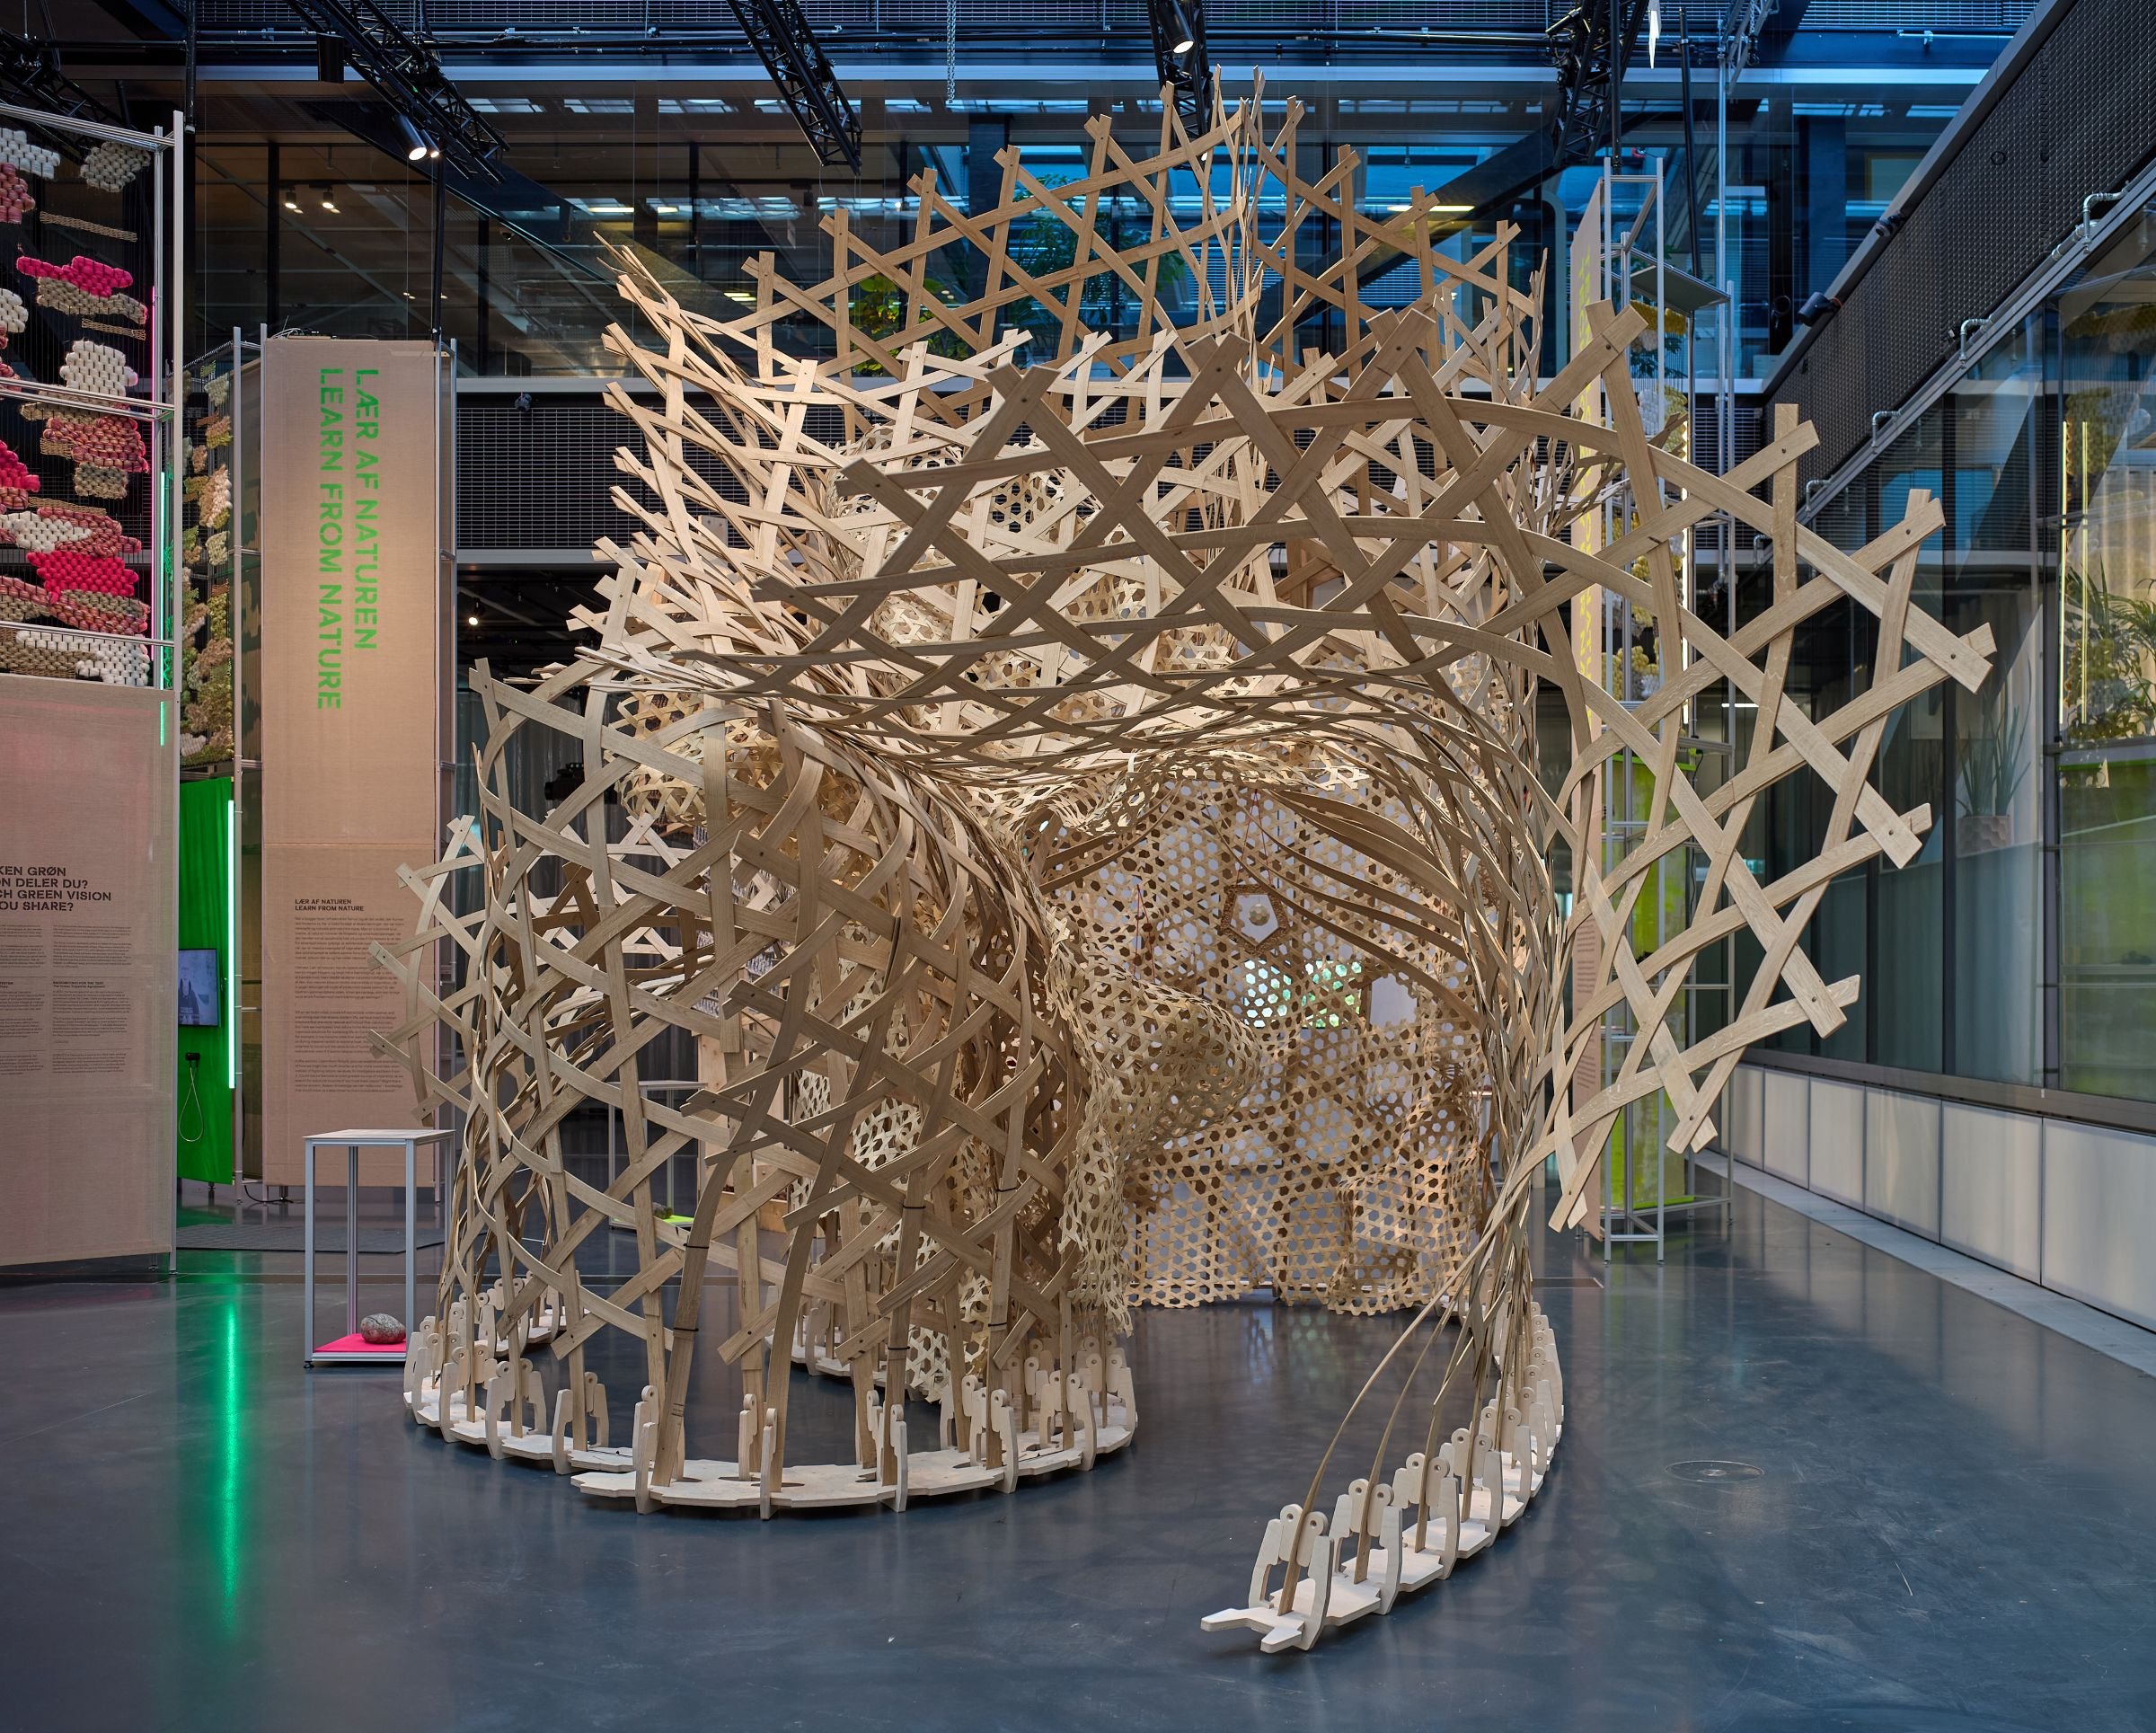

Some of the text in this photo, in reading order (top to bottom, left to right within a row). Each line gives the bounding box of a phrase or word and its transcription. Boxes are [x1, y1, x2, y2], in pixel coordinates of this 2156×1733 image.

[353, 367, 382, 650] LÆR AF NATUREN
[316, 367, 345, 711] LEARN FROM NATURE
[27, 866, 66, 878] GRØN
[15, 878, 58, 889] DELER
[62, 879, 89, 890] DU?
[17, 889, 63, 901] GREEN
[66, 891, 111, 903] VISION
[22, 901, 75, 912] SHARE?
